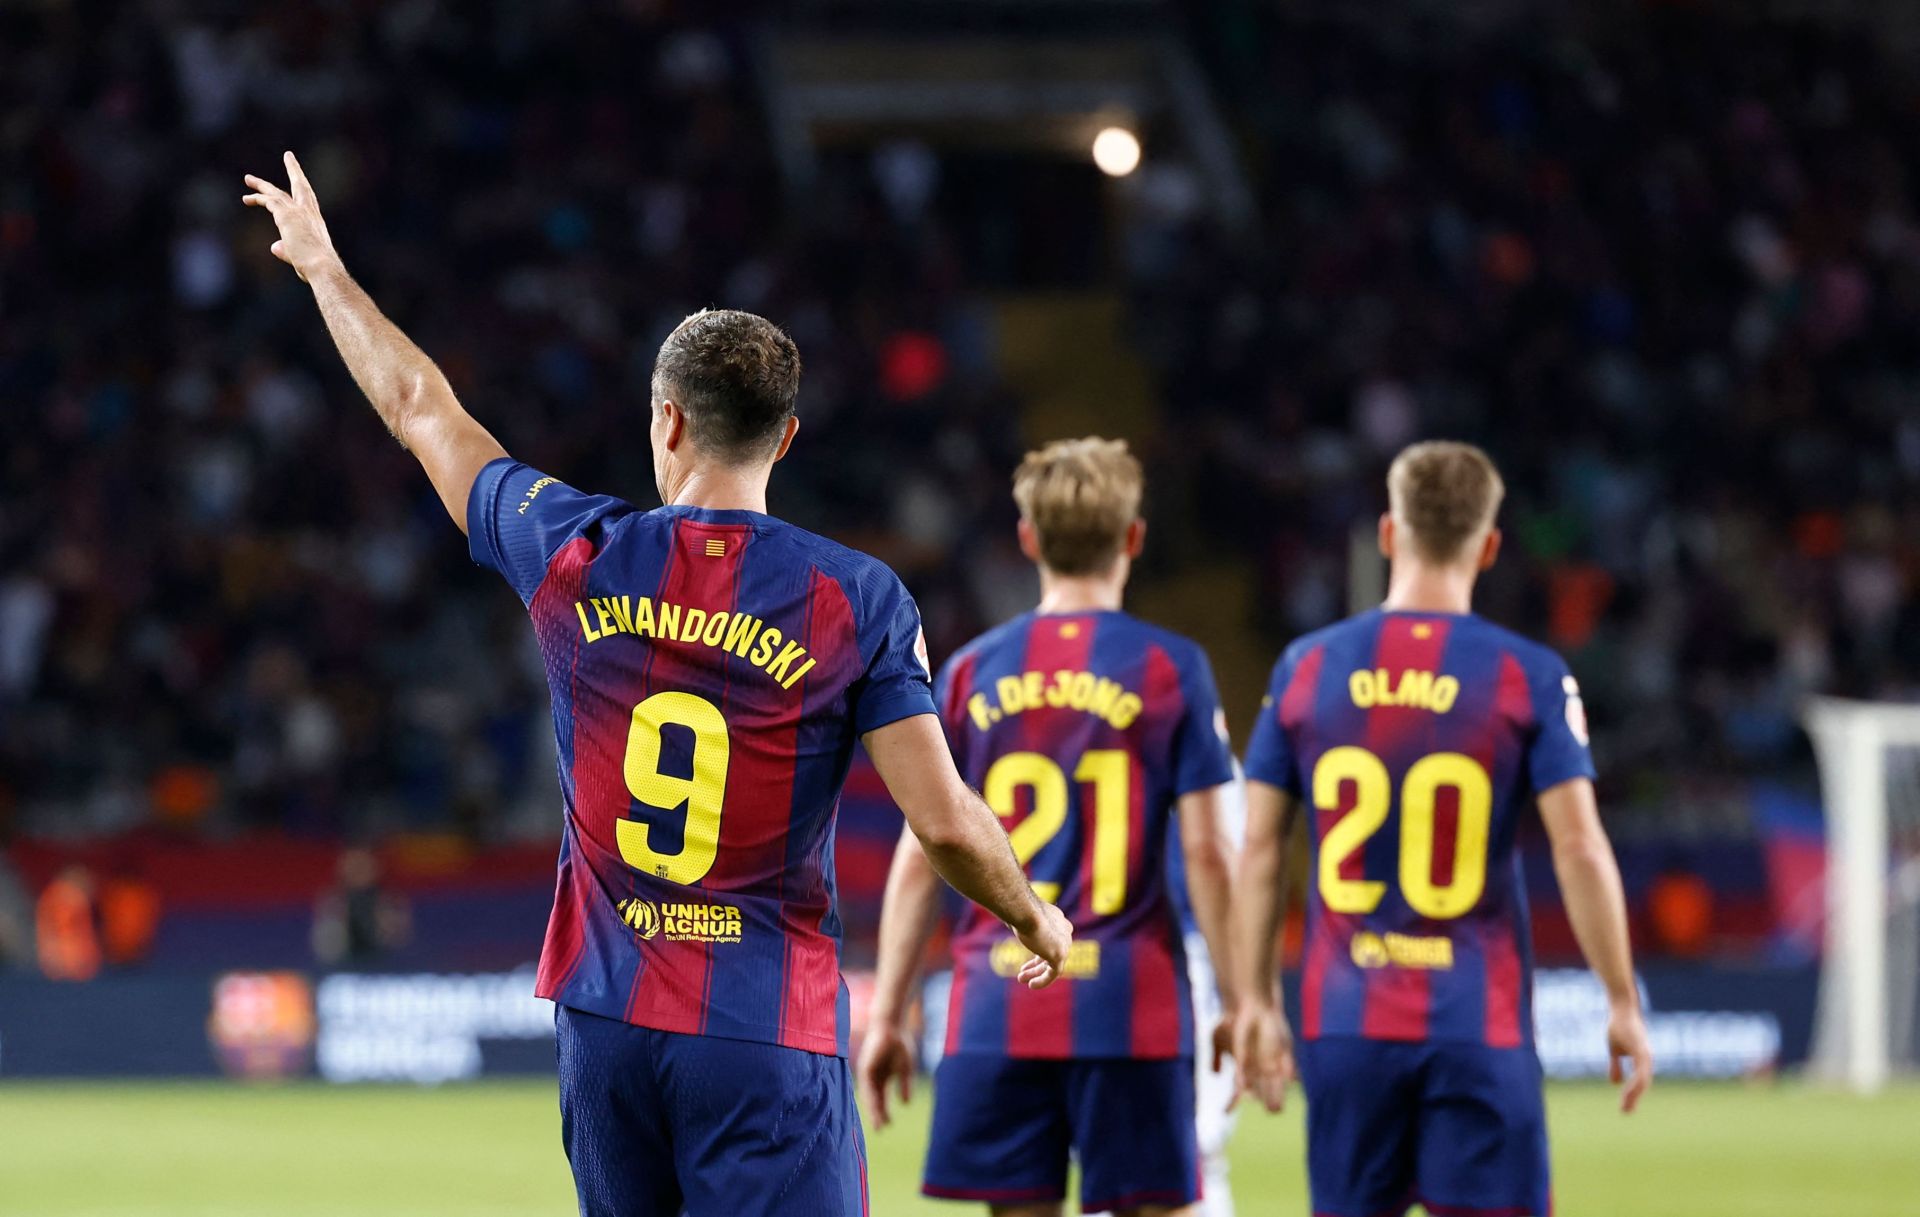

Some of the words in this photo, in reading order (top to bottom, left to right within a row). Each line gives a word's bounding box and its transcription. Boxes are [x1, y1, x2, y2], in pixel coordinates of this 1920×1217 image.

[574, 595, 816, 690] LEWANDOWSKI
[995, 670, 1045, 716] DE
[1045, 669, 1143, 730] JONG
[1348, 669, 1460, 715] OLMO
[615, 691, 730, 886] 9
[984, 749, 1130, 915] 21
[1312, 746, 1492, 920] 20
[661, 903, 742, 921] UNHCR
[664, 917, 742, 935] ACNUR
[686, 934, 714, 943] Refugee
[715, 936, 742, 944] Agency
